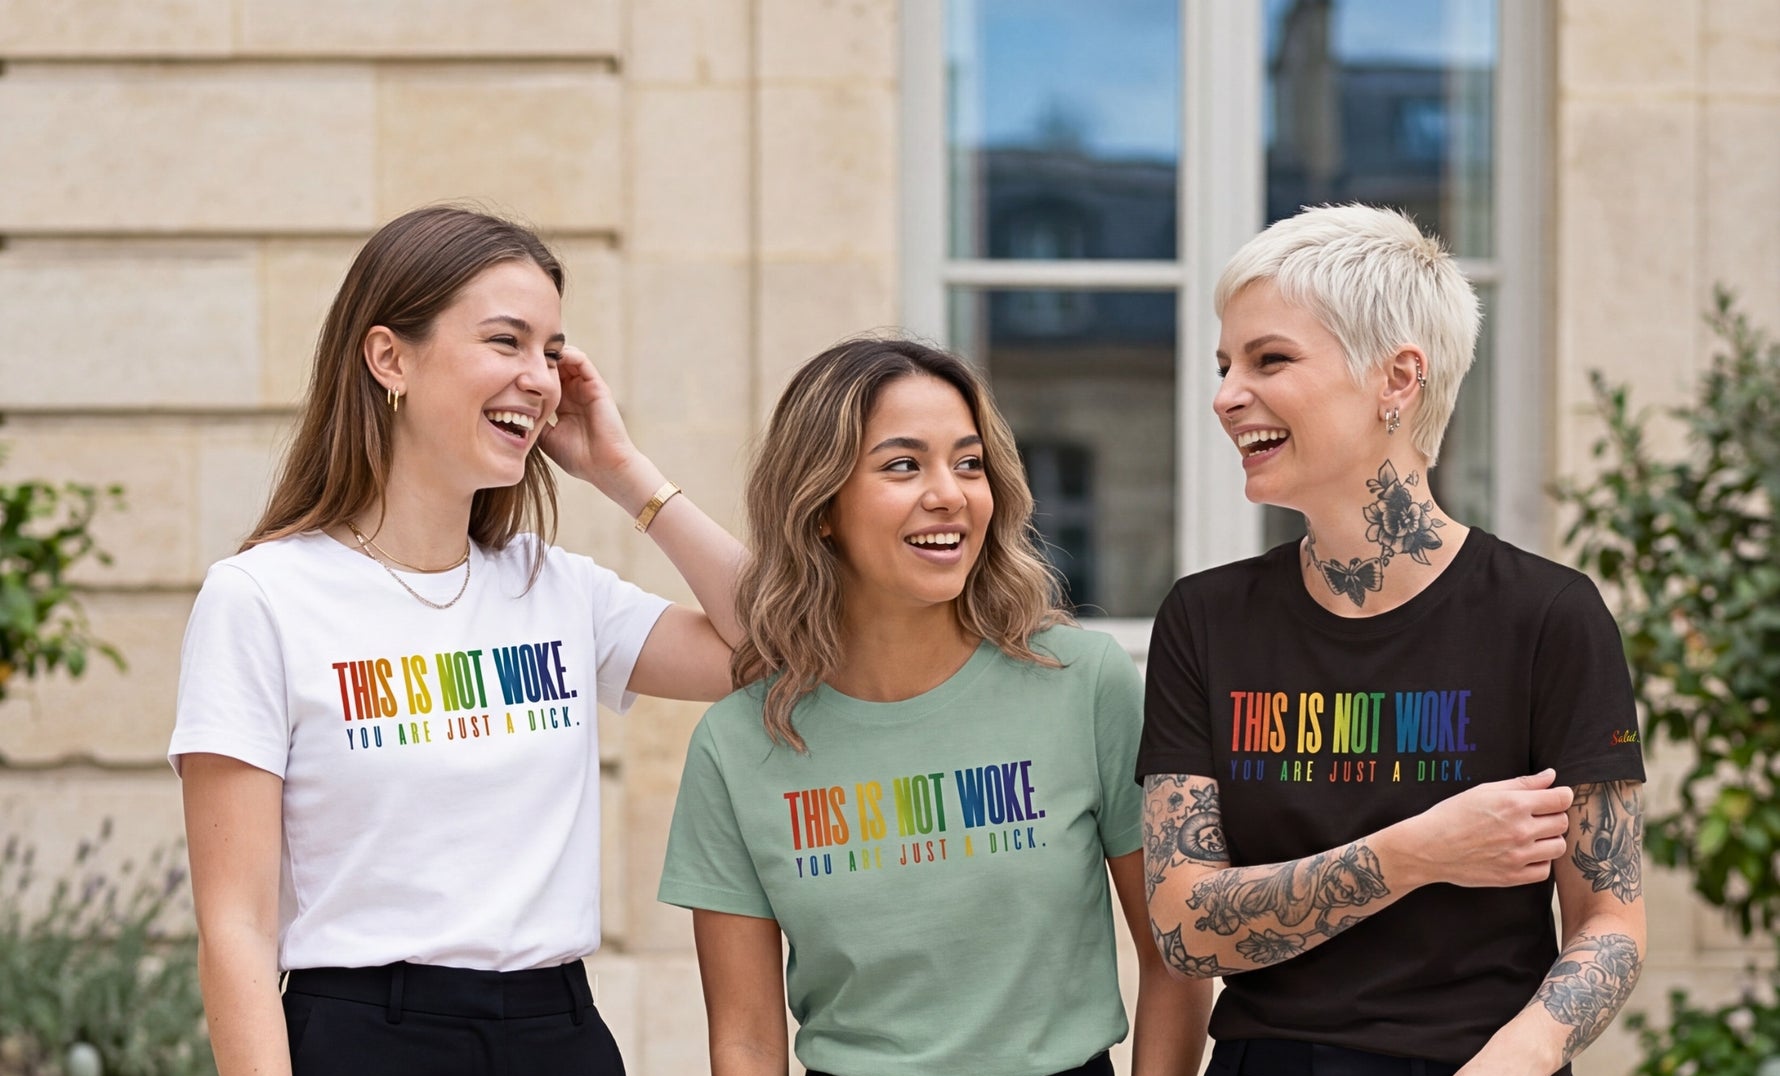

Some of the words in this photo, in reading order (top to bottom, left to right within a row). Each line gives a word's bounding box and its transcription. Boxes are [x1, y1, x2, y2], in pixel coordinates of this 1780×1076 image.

[332, 658, 398, 721] THIS
[401, 655, 432, 715] IS
[435, 650, 488, 712] NOT
[492, 640, 578, 705] WOKE.
[347, 725, 382, 750] YOU
[399, 721, 431, 745] ARE
[447, 715, 491, 740] JUST
[507, 712, 515, 734] A
[528, 706, 580, 732] DICK.
[1230, 691, 1288, 753] THIS
[1297, 692, 1324, 754] IS
[1332, 692, 1385, 754] NOT
[1395, 690, 1476, 753] WOKE.
[1230, 760, 1265, 781] YOU
[1280, 760, 1314, 782] ARE
[1329, 760, 1377, 783] JUST
[1392, 760, 1401, 782] A
[1418, 759, 1471, 782] DICK.
[784, 786, 849, 850] THIS
[855, 781, 887, 842] IS
[893, 772, 946, 837] NOT
[955, 760, 1046, 829] WOKE.
[796, 853, 832, 878] YOU
[849, 846, 882, 872] ARE
[900, 838, 947, 866] JUST
[965, 835, 974, 857] A
[989, 827, 1046, 854] DICK.
